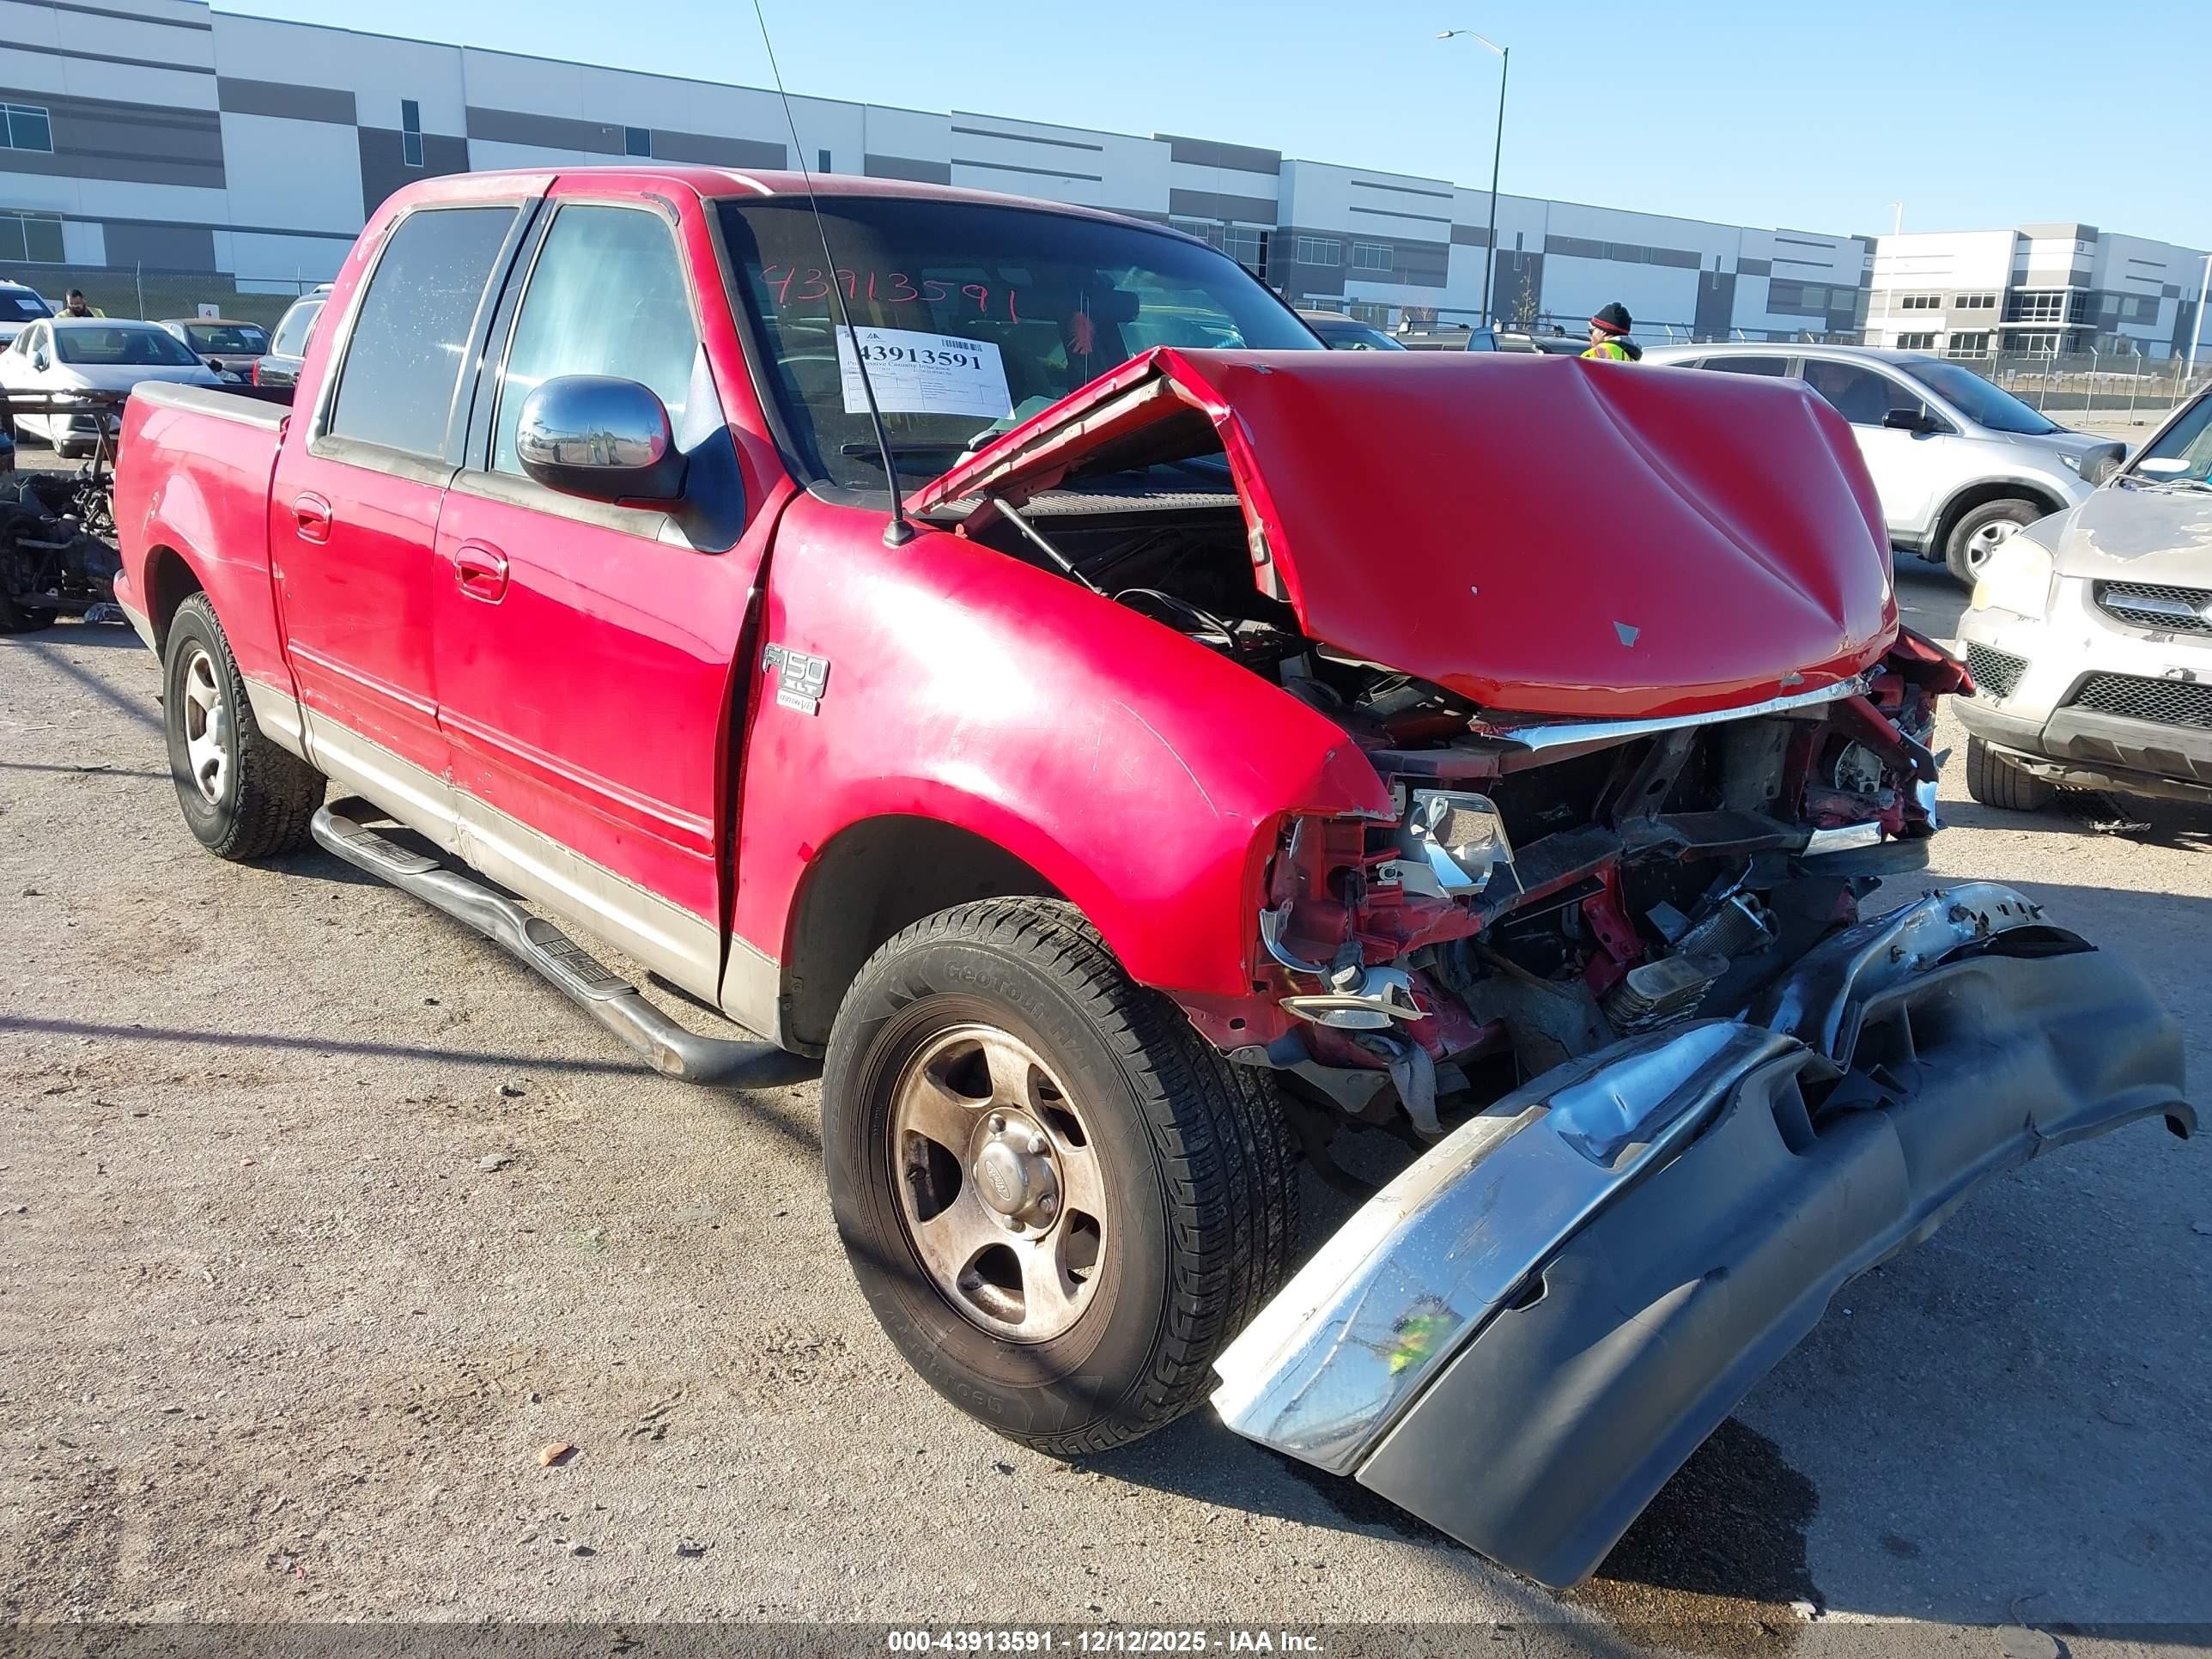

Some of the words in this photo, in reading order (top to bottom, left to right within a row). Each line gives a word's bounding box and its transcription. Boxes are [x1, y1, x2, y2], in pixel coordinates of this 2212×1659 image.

[758, 264, 1018, 325] 43913591
[860, 344, 983, 371] 43913591
[783, 678, 817, 695] XLT
